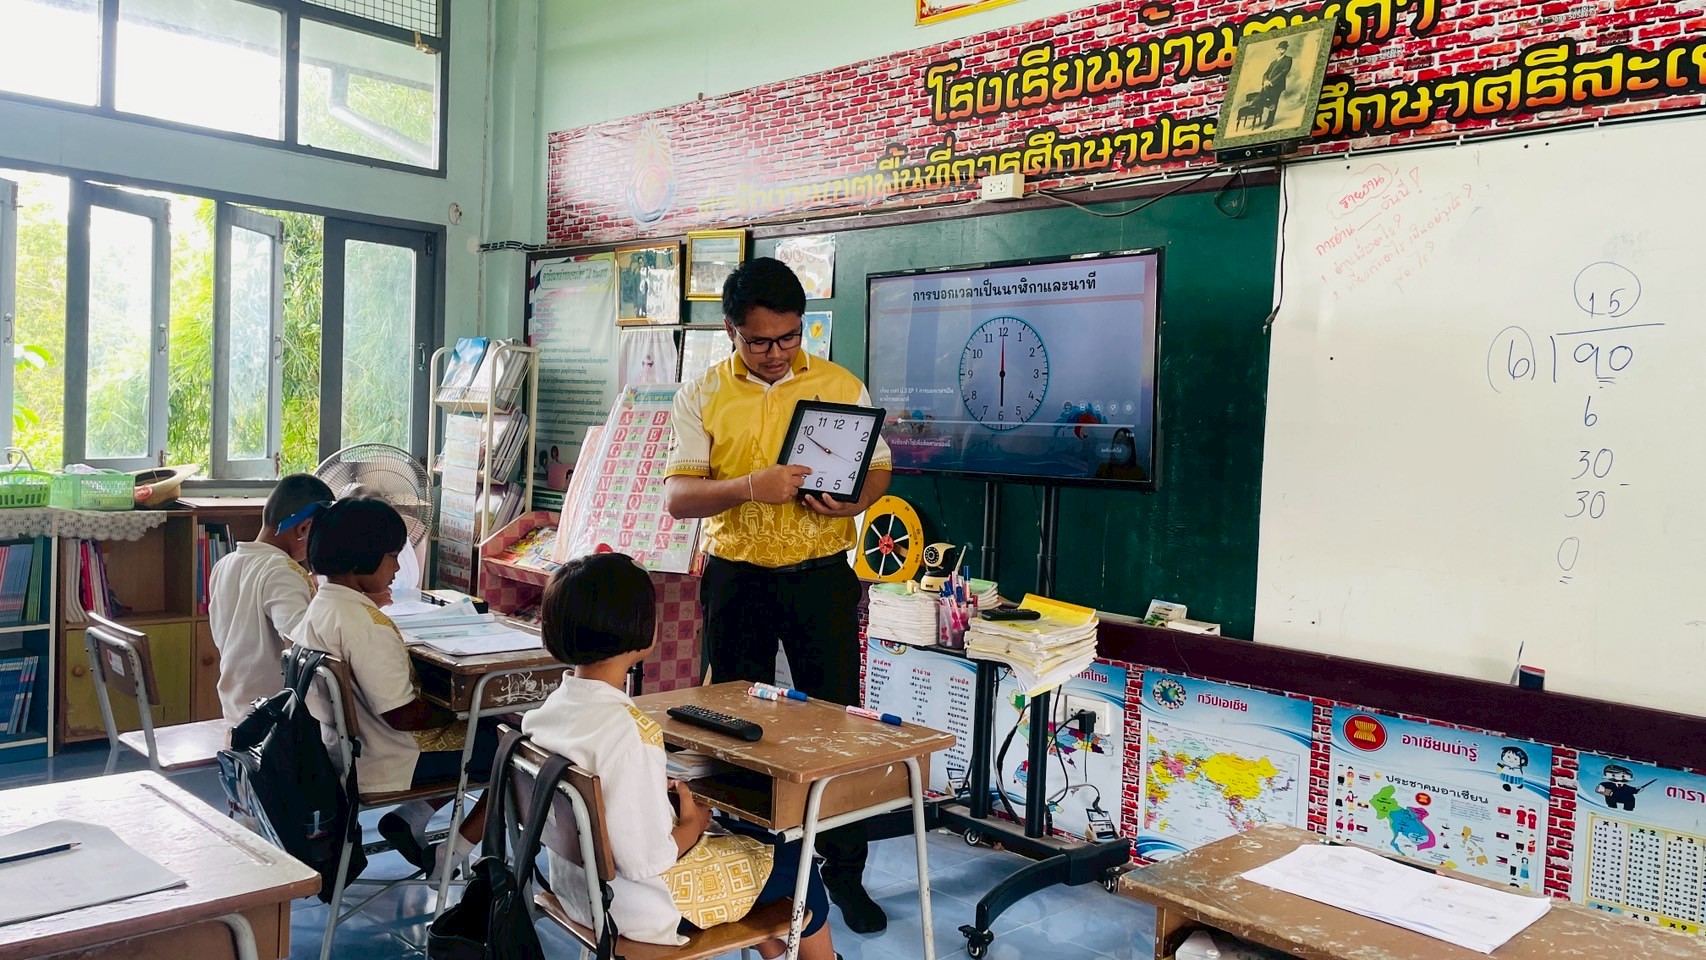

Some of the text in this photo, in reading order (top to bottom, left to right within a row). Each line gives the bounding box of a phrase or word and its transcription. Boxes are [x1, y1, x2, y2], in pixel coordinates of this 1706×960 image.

[912, 272, 1096, 302] การบอกเวลาเป็นนาฬิกาและนาที
[998, 327, 1008, 338] 12
[1018, 332, 1022, 342] 1
[984, 334, 994, 344] 11
[972, 349, 983, 359] 10
[1029, 348, 1035, 358] 2
[1507, 339, 1633, 380] 6 90
[968, 369, 974, 379] 9
[1034, 369, 1040, 378] 3
[971, 390, 978, 400] 8
[1028, 390, 1034, 400] 4
[982, 406, 988, 416] 7
[998, 411, 1004, 421] 6
[1016, 406, 1022, 416] 5
[1584, 395, 1598, 427] 6
[818, 417, 828, 427] 11
[833, 419, 845, 430] 12
[854, 421, 860, 431] 1
[803, 425, 814, 436] 10
[860, 431, 869, 442] 2
[797, 444, 805, 454] 9
[854, 451, 863, 462] 3
[1571, 448, 1614, 480] 30
[848, 470, 856, 481] 4
[815, 477, 823, 488] 6
[833, 480, 841, 490] 5
[1564, 490, 1606, 519] 30
[1198, 693, 1248, 712] ทวีปเอเชีย
[1402, 734, 1478, 762] อาเซียนน่ารู้
[1386, 775, 1489, 804] ประชาคมอาเซียน
[1666, 786, 1706, 804] ตารา
